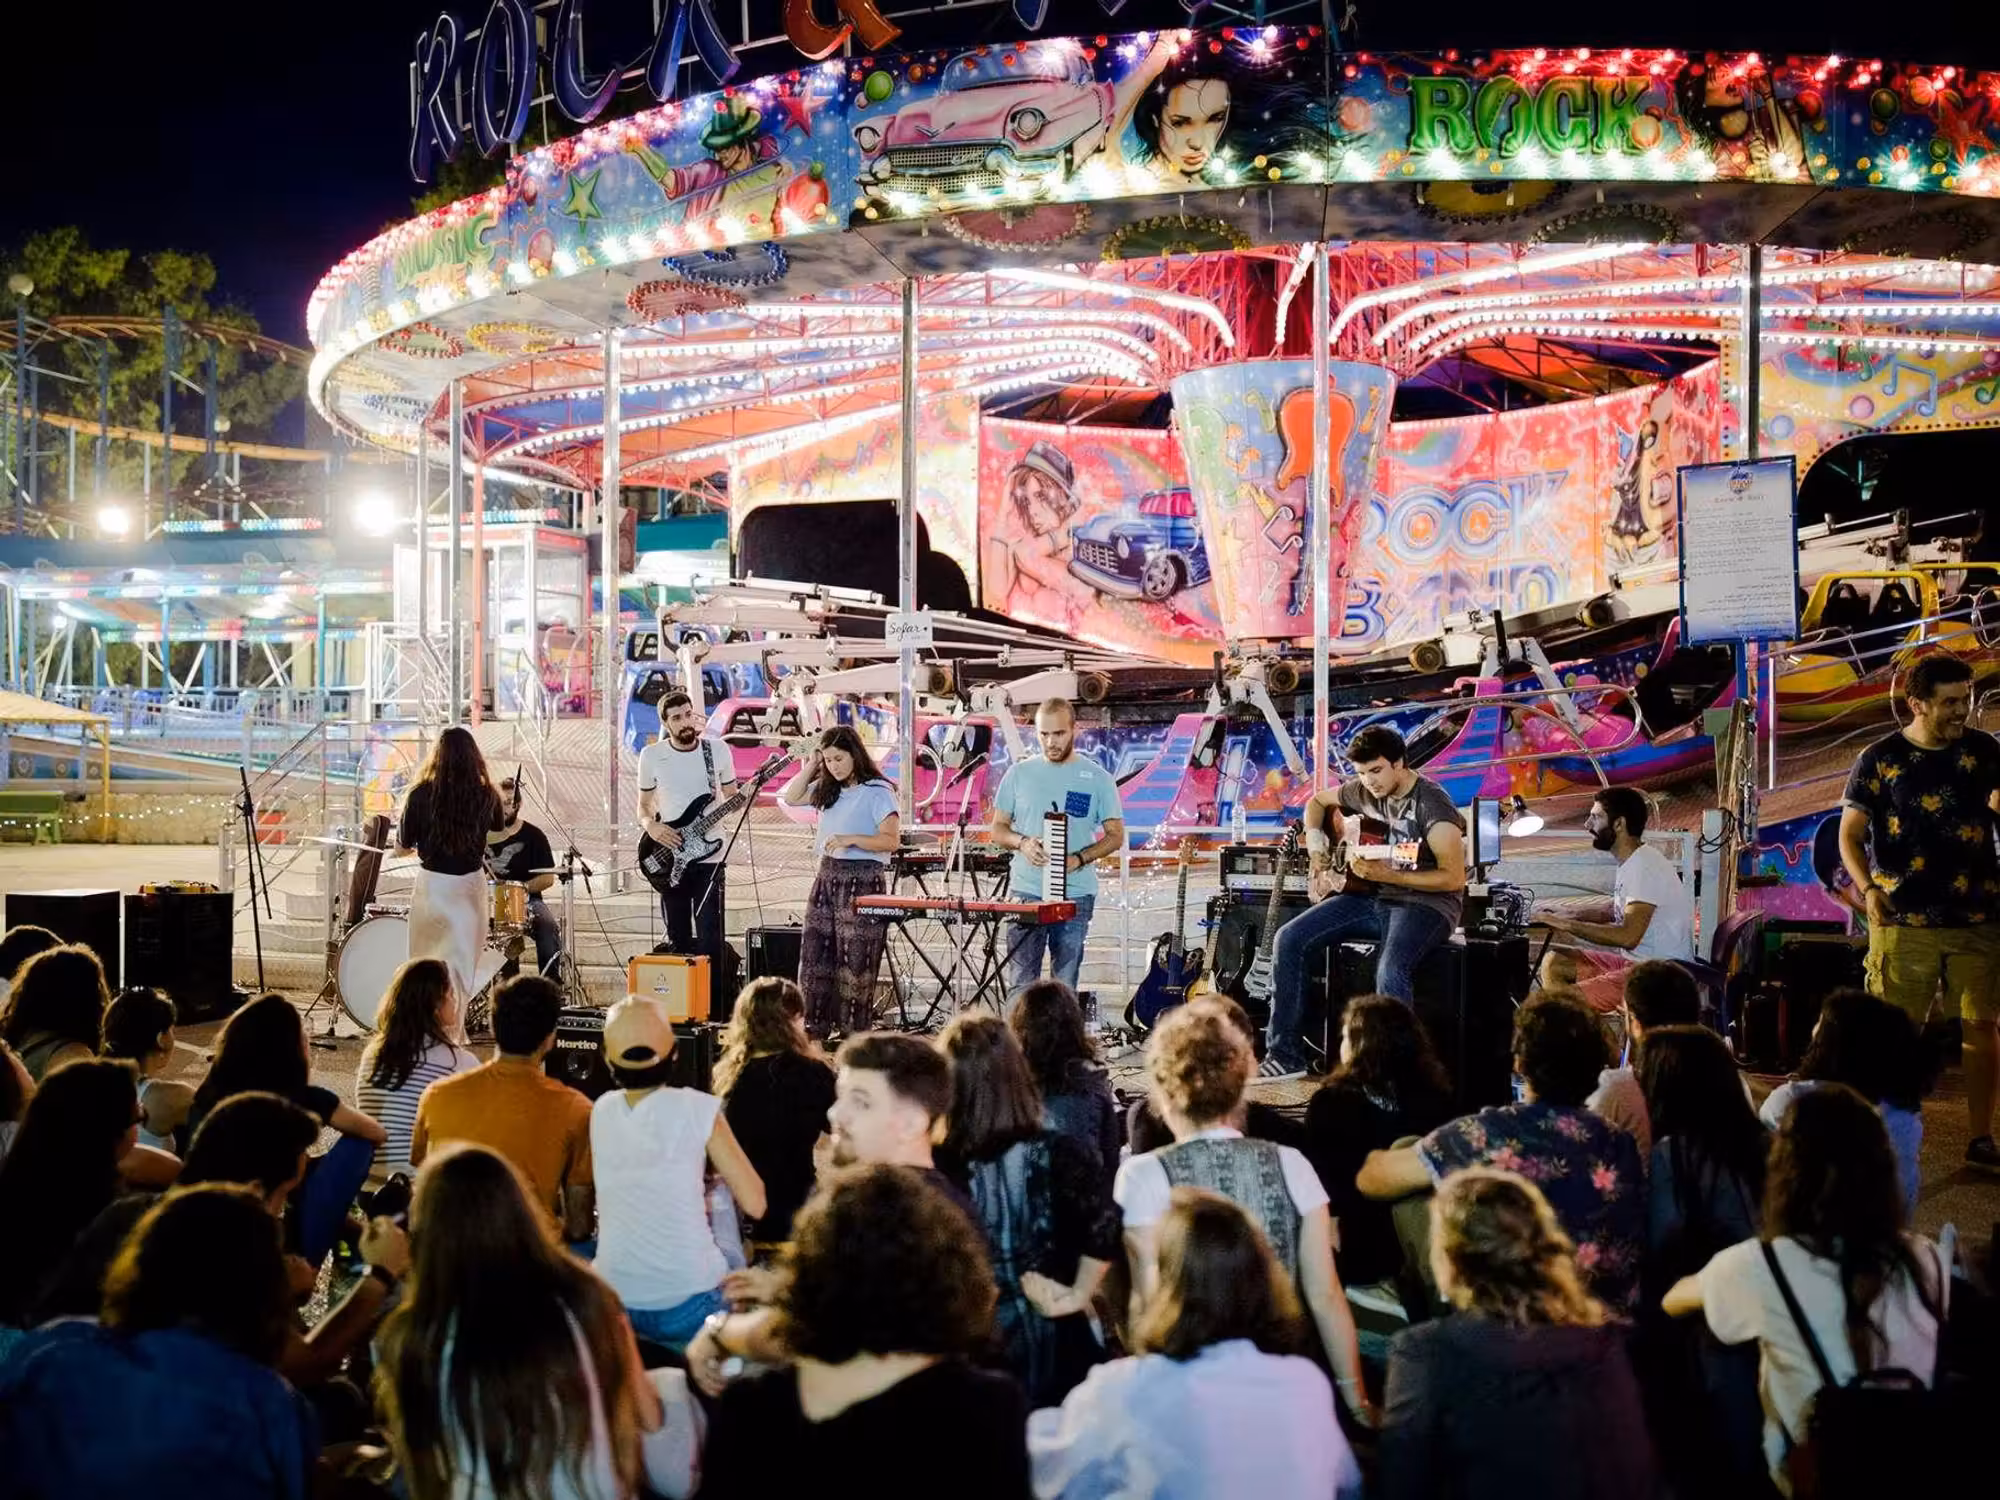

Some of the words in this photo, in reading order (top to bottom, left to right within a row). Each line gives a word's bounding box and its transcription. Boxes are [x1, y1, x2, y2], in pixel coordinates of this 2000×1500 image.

[1408, 74, 1652, 158] ROCK
[395, 212, 497, 291] MUSIC
[889, 621, 922, 641] Sofar
[556, 1039, 598, 1050] Hartke
